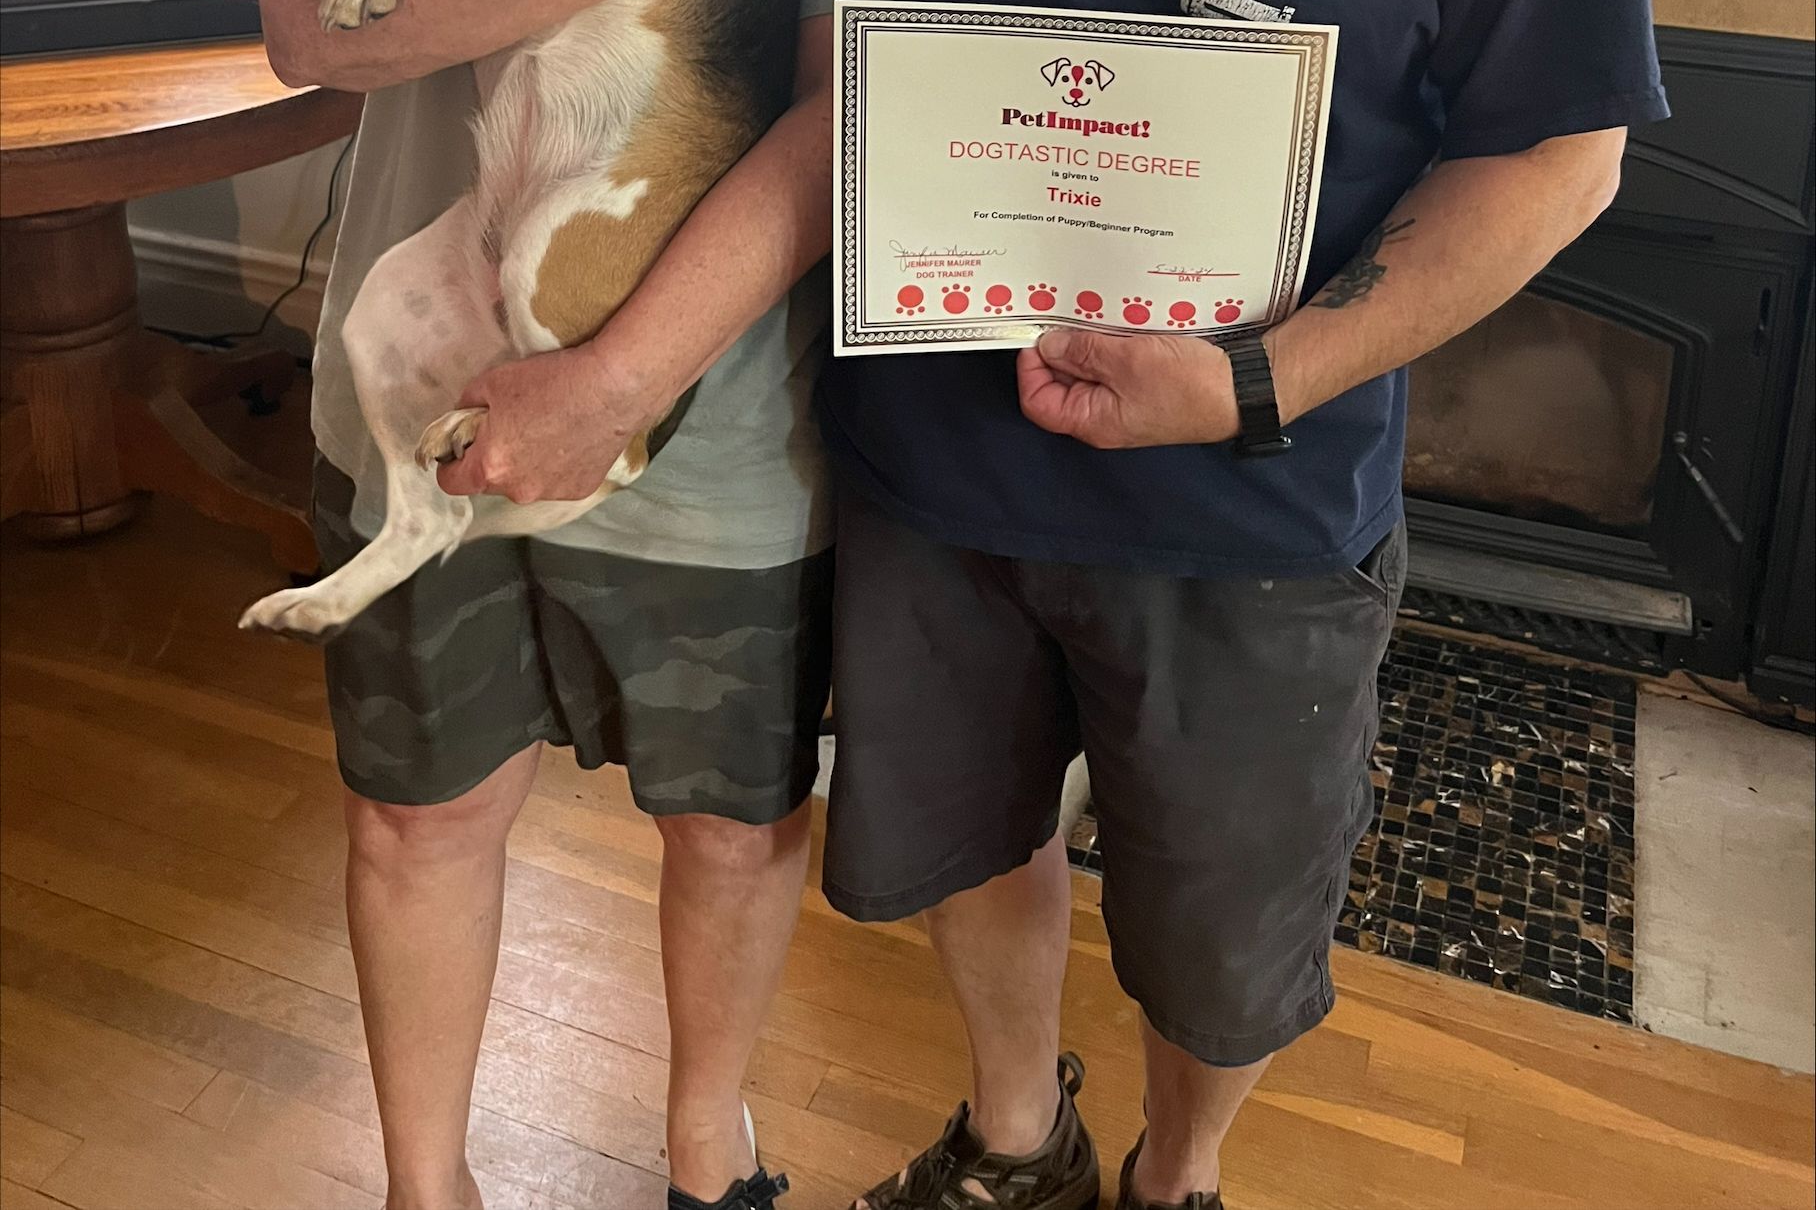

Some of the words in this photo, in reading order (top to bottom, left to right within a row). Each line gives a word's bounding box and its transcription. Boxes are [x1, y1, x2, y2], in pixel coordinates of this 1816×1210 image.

[1001, 107, 1151, 138] PetImpact!
[949, 141, 1089, 166] DOGTASTIC
[1097, 151, 1201, 178] DEGREE
[1051, 169, 1060, 178] is
[1062, 171, 1088, 182] given
[1089, 174, 1099, 182] to
[1046, 186, 1102, 207] Trixie
[973, 211, 989, 220] For
[991, 211, 1044, 223] Completion
[1046, 215, 1056, 223] of
[1057, 215, 1131, 234] Puppy/Beginner
[1133, 226, 1174, 237] Program
[906, 259, 945, 268] JENNIFER
[947, 259, 982, 267] MAURER
[916, 271, 935, 279] DOG
[938, 270, 974, 279] TRAINER
[1178, 275, 1202, 283] DATE
